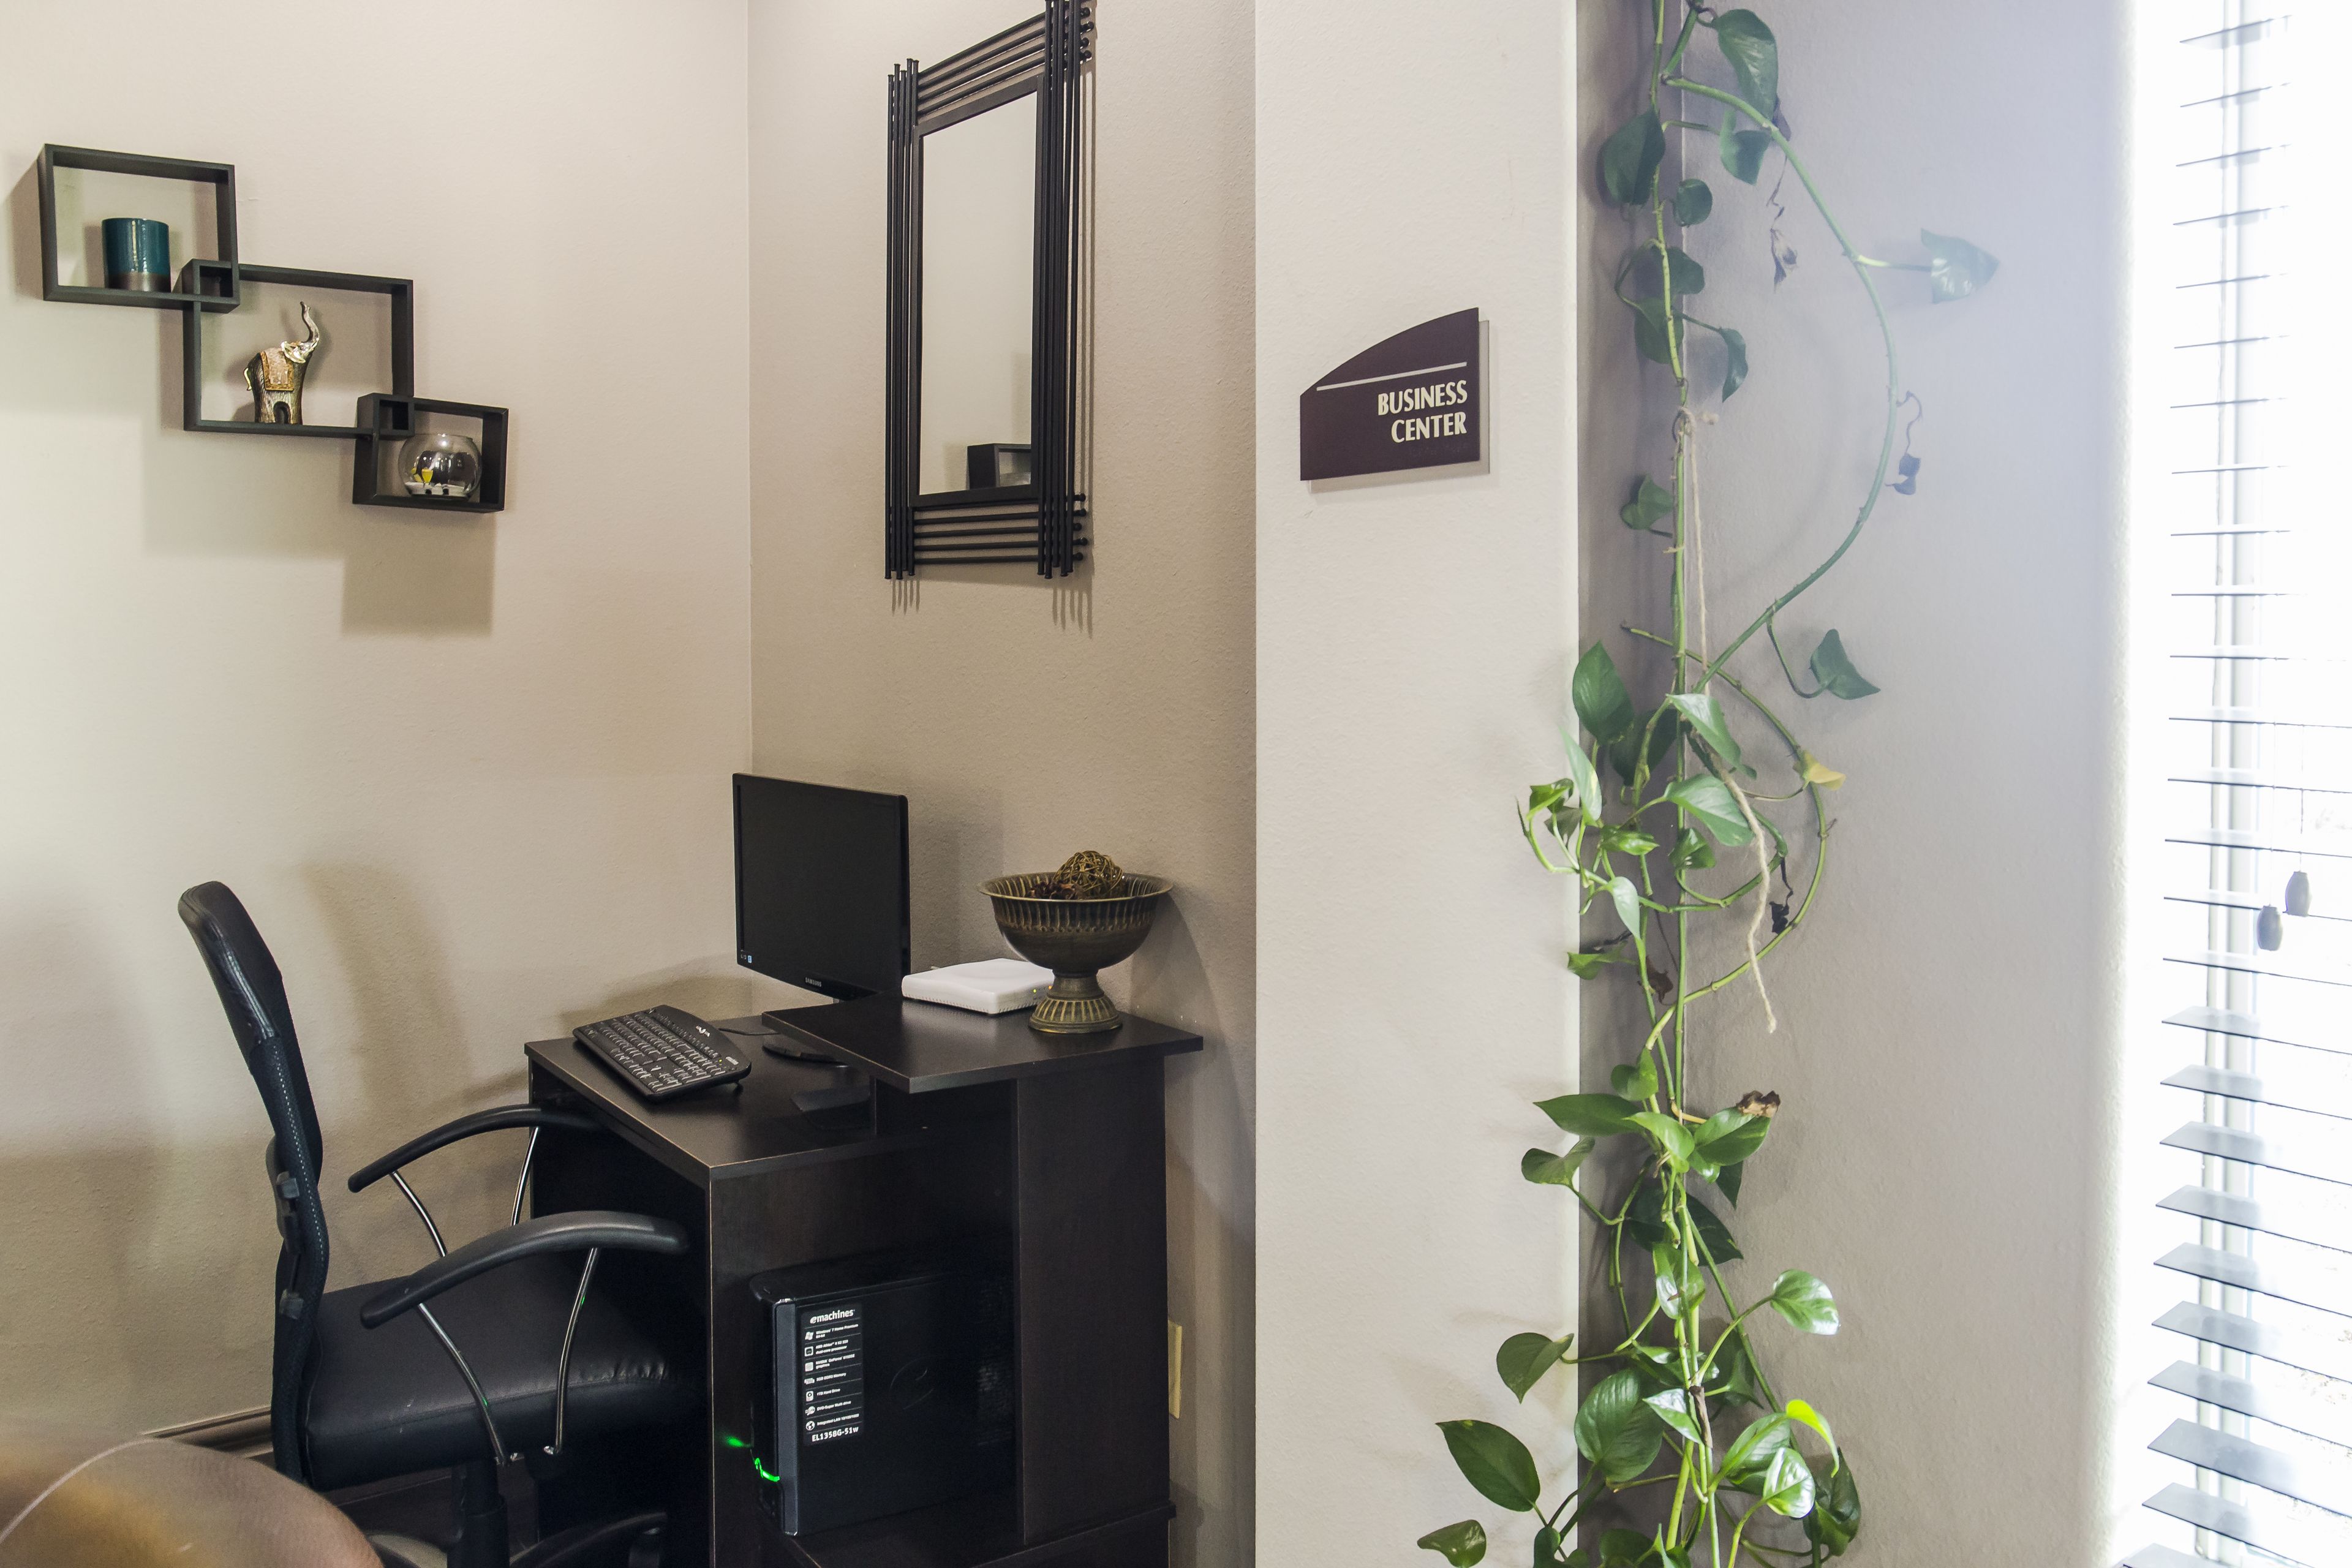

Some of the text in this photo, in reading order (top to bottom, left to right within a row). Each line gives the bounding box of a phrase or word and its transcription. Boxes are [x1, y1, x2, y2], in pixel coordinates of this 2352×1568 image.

[1378, 380, 1468, 415] BUSINESS
[1391, 412, 1467, 443] CENTER
[810, 1310, 854, 1324] emachines
